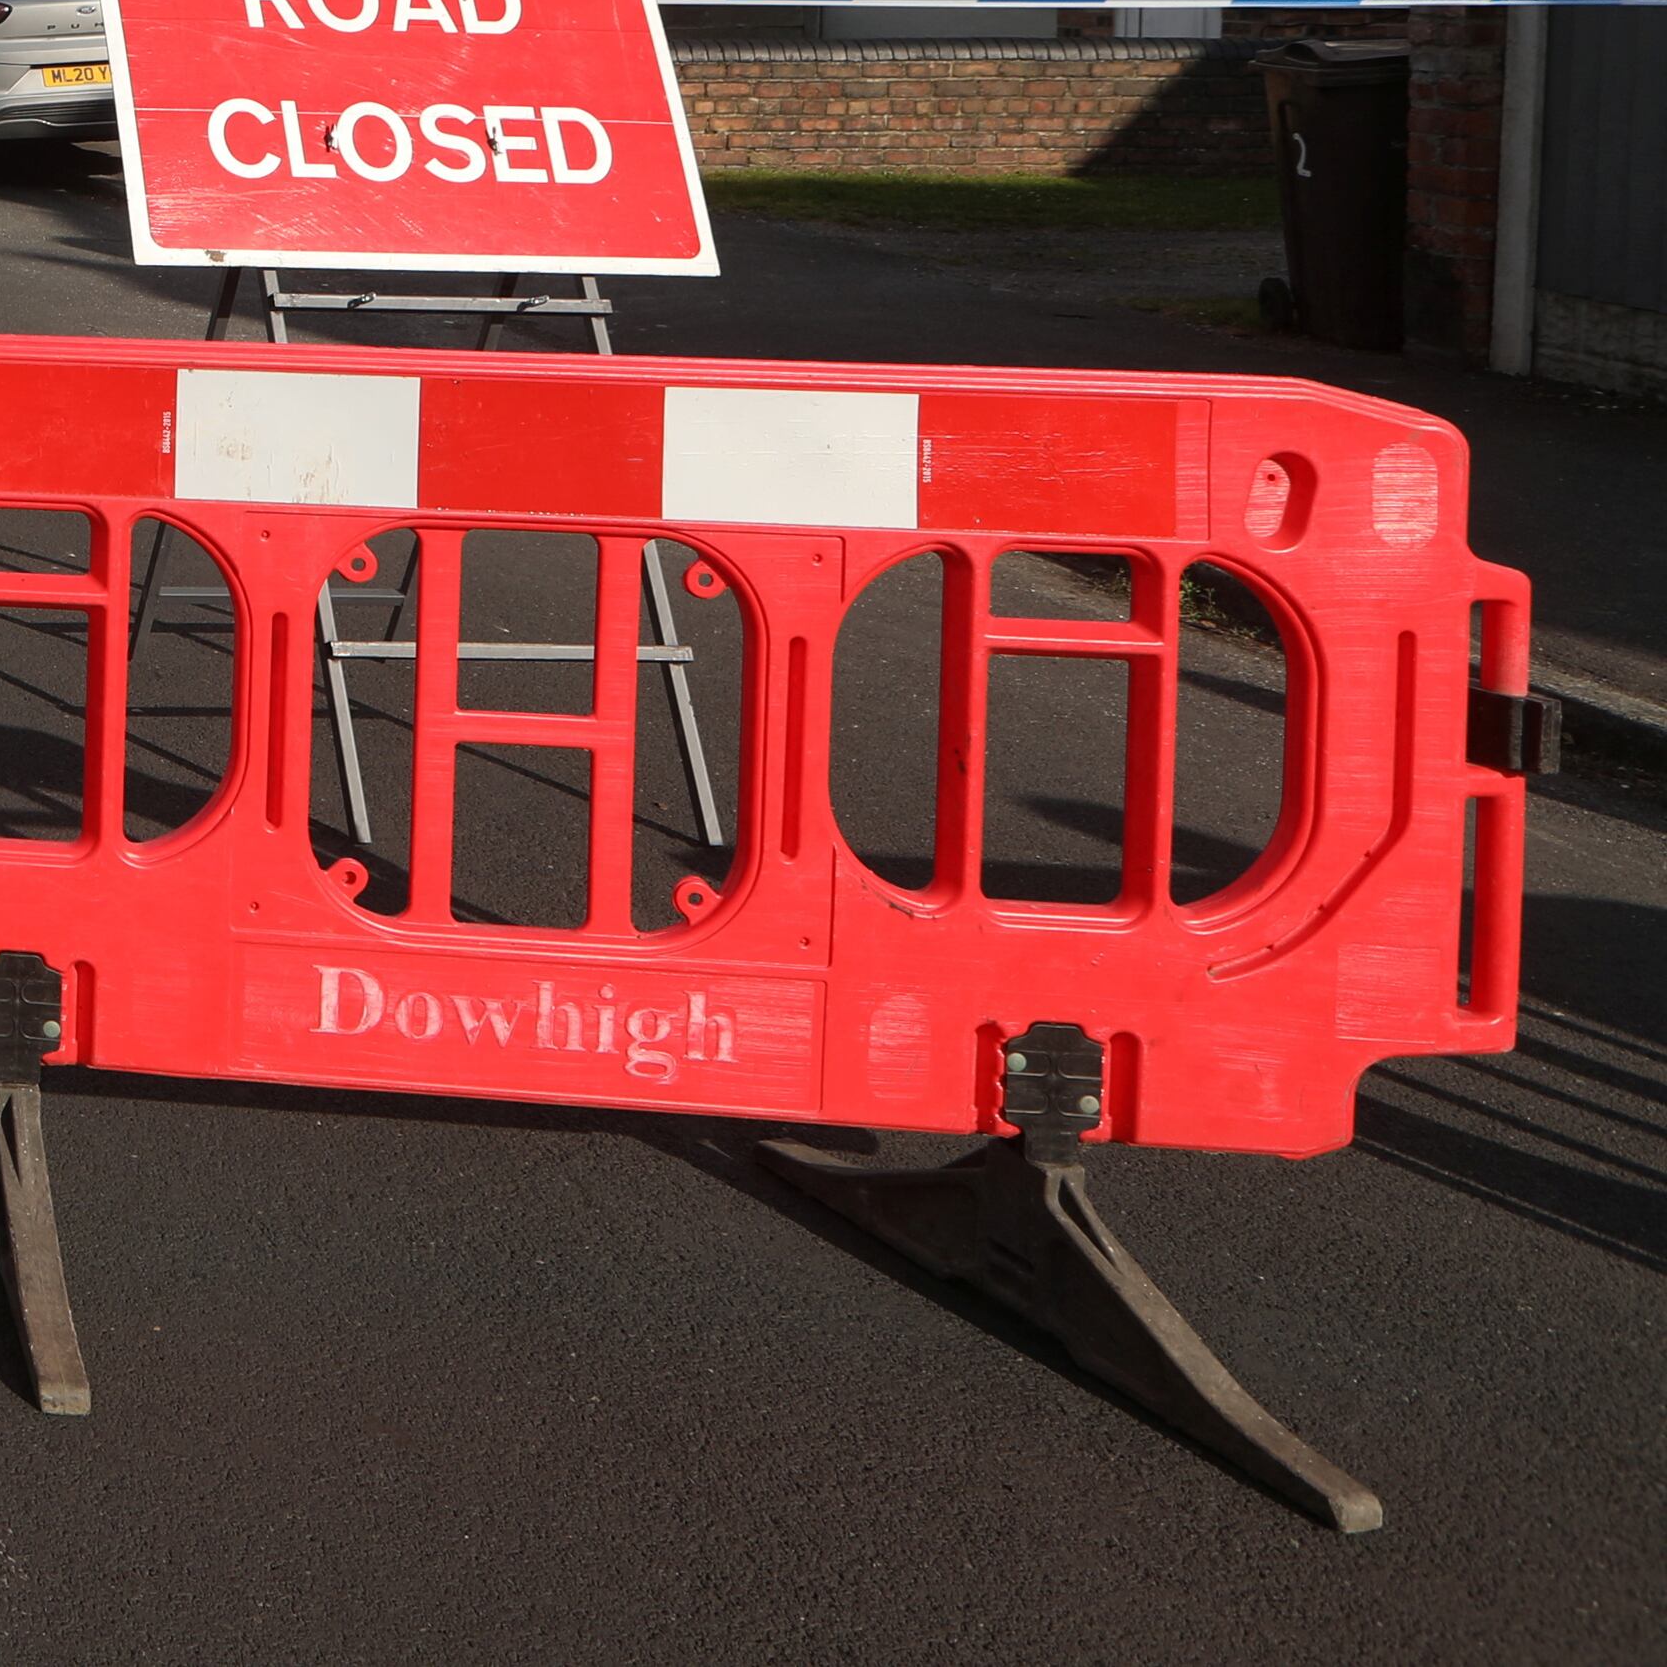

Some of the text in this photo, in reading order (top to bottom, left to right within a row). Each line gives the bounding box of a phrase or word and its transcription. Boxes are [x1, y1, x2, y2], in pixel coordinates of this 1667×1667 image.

[52, 68, 94, 83] ML20
[207, 97, 614, 184] CLOSED
[1292, 132, 1312, 178] 2
[310, 963, 735, 1084] Dowhigh
